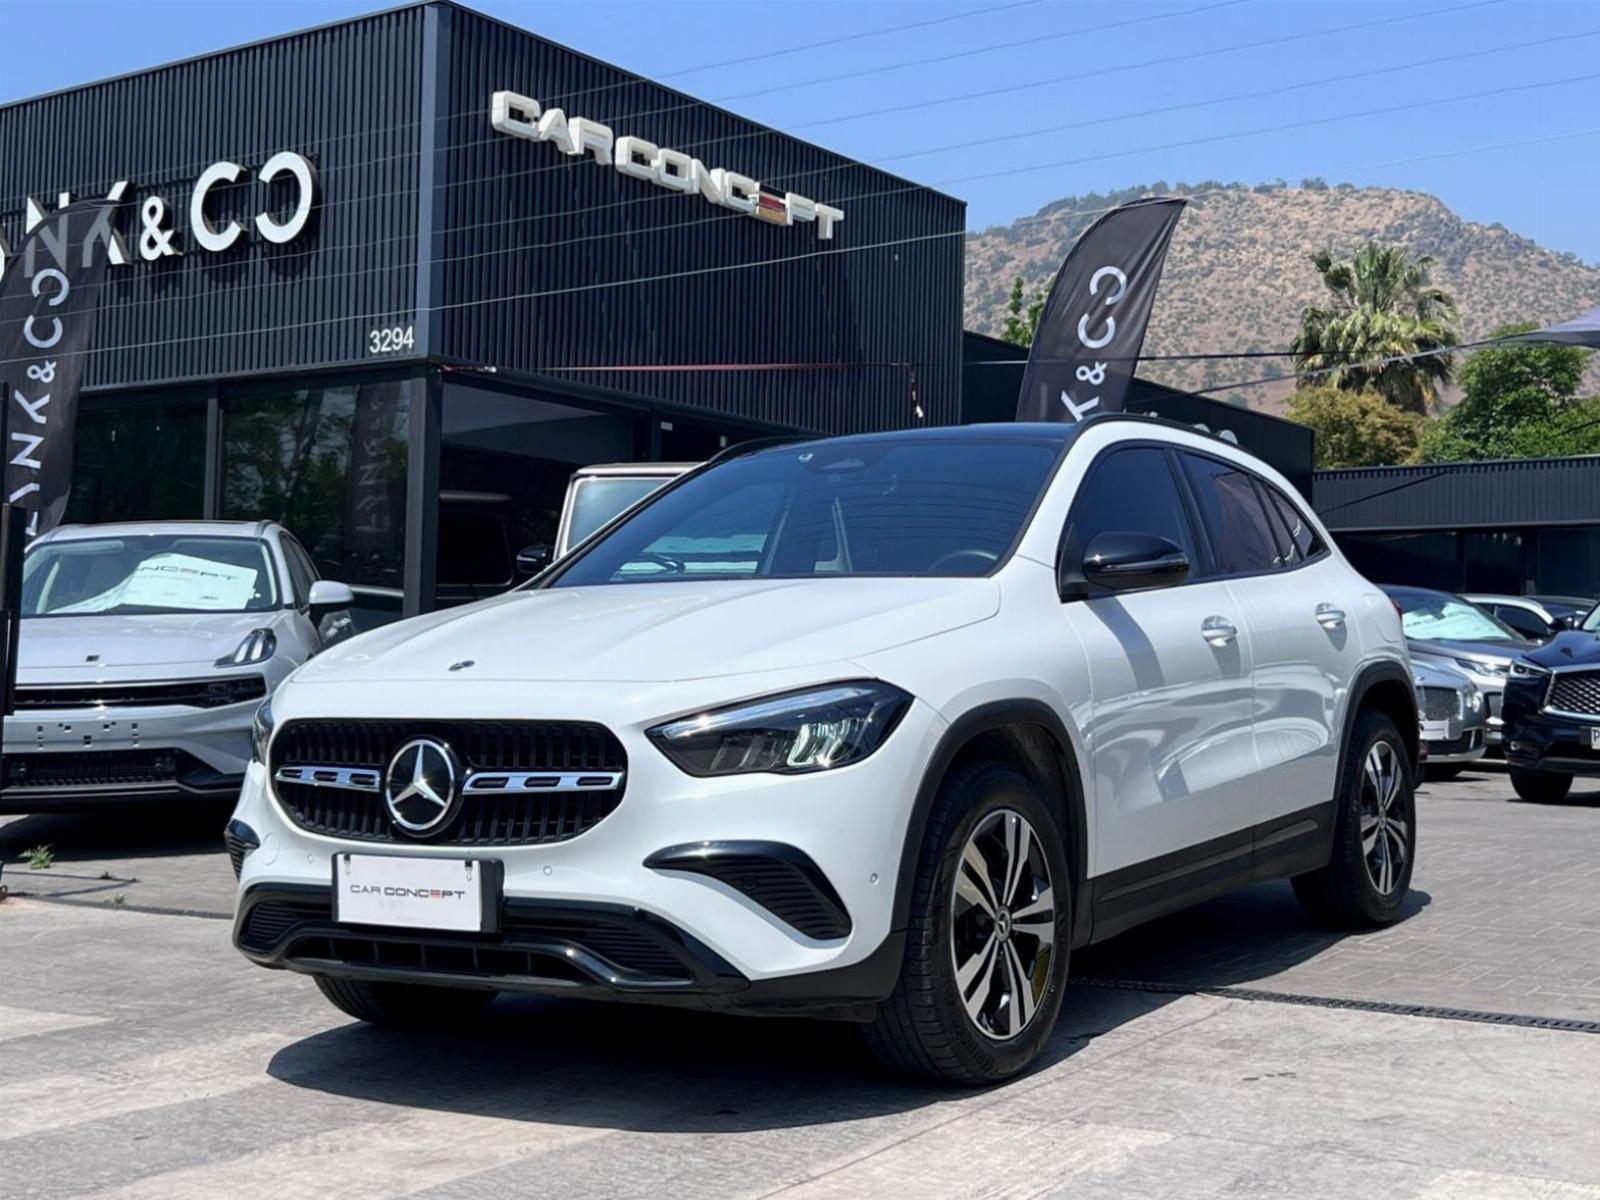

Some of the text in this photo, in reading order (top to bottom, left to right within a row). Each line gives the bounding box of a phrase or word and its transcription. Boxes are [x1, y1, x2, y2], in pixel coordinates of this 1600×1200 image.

[369, 325, 415, 353] 3294
[350, 884, 466, 900] CAR CONCEPT
